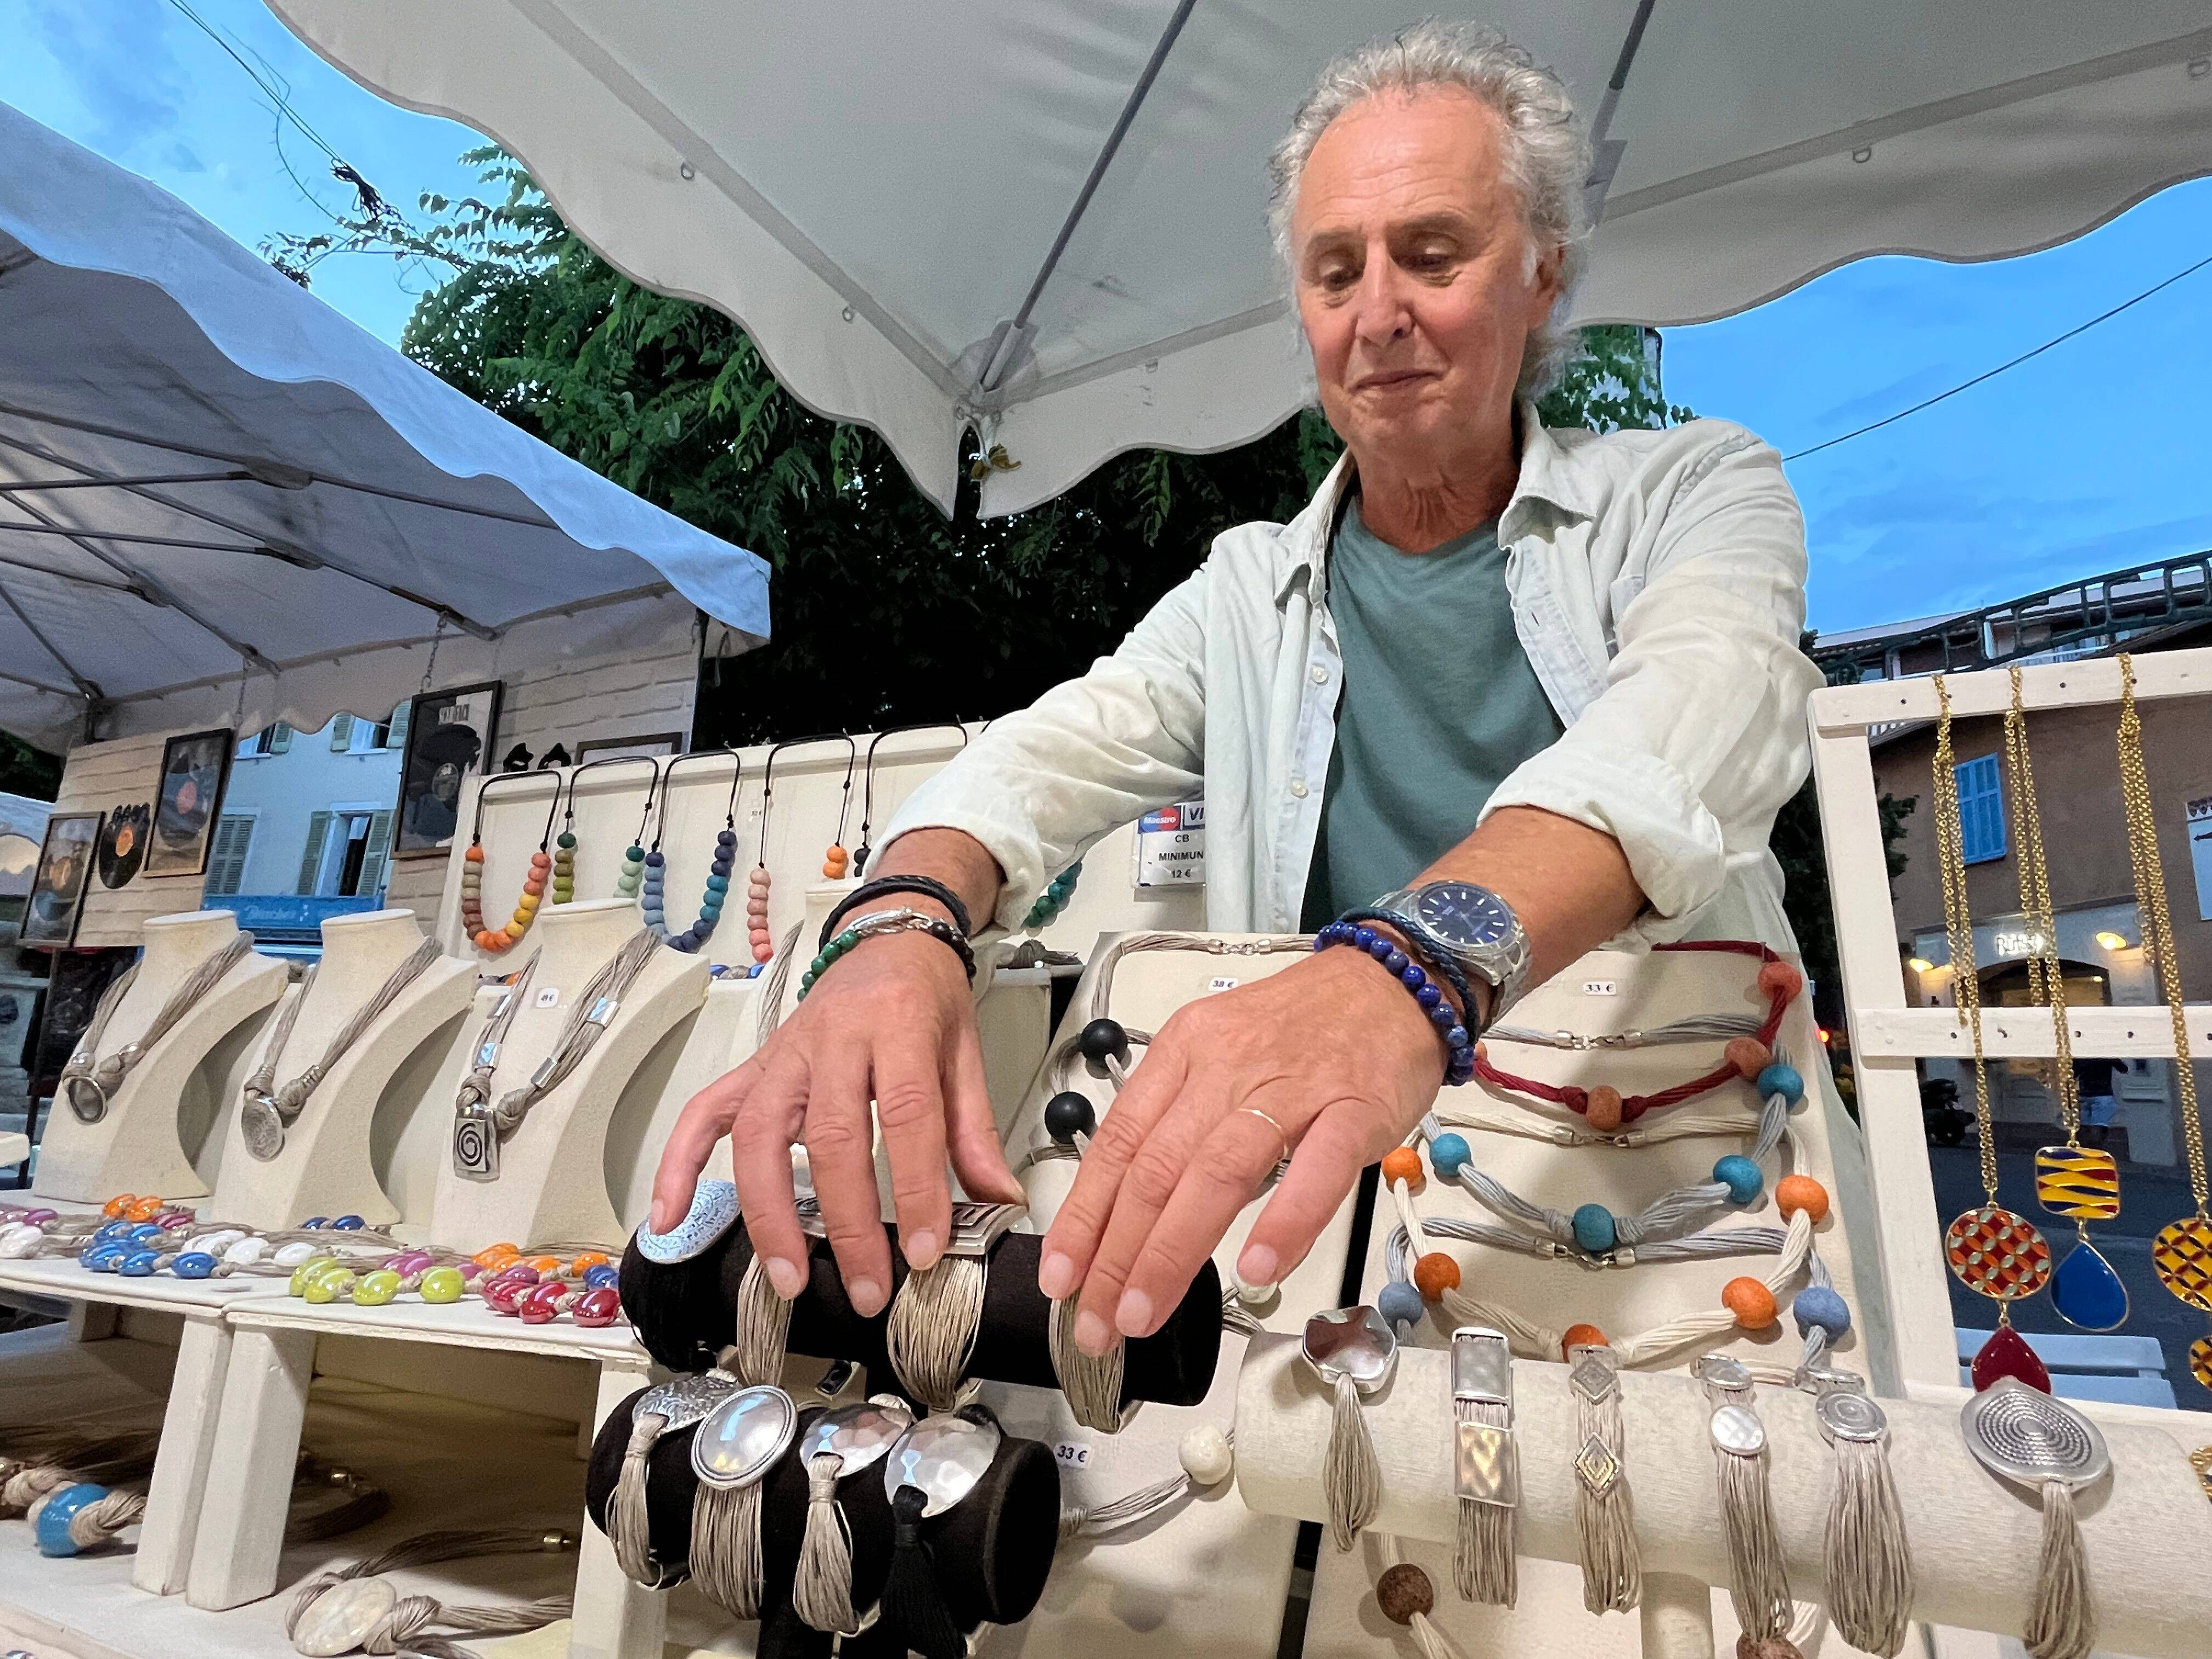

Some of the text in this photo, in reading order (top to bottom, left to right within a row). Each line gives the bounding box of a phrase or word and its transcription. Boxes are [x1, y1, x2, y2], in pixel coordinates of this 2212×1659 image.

[1175, 834, 1189, 843] CB
[1172, 869, 1192, 878] 12 €
[1606, 984, 1614, 992] €
[1057, 1445, 1087, 1463] 33 €
